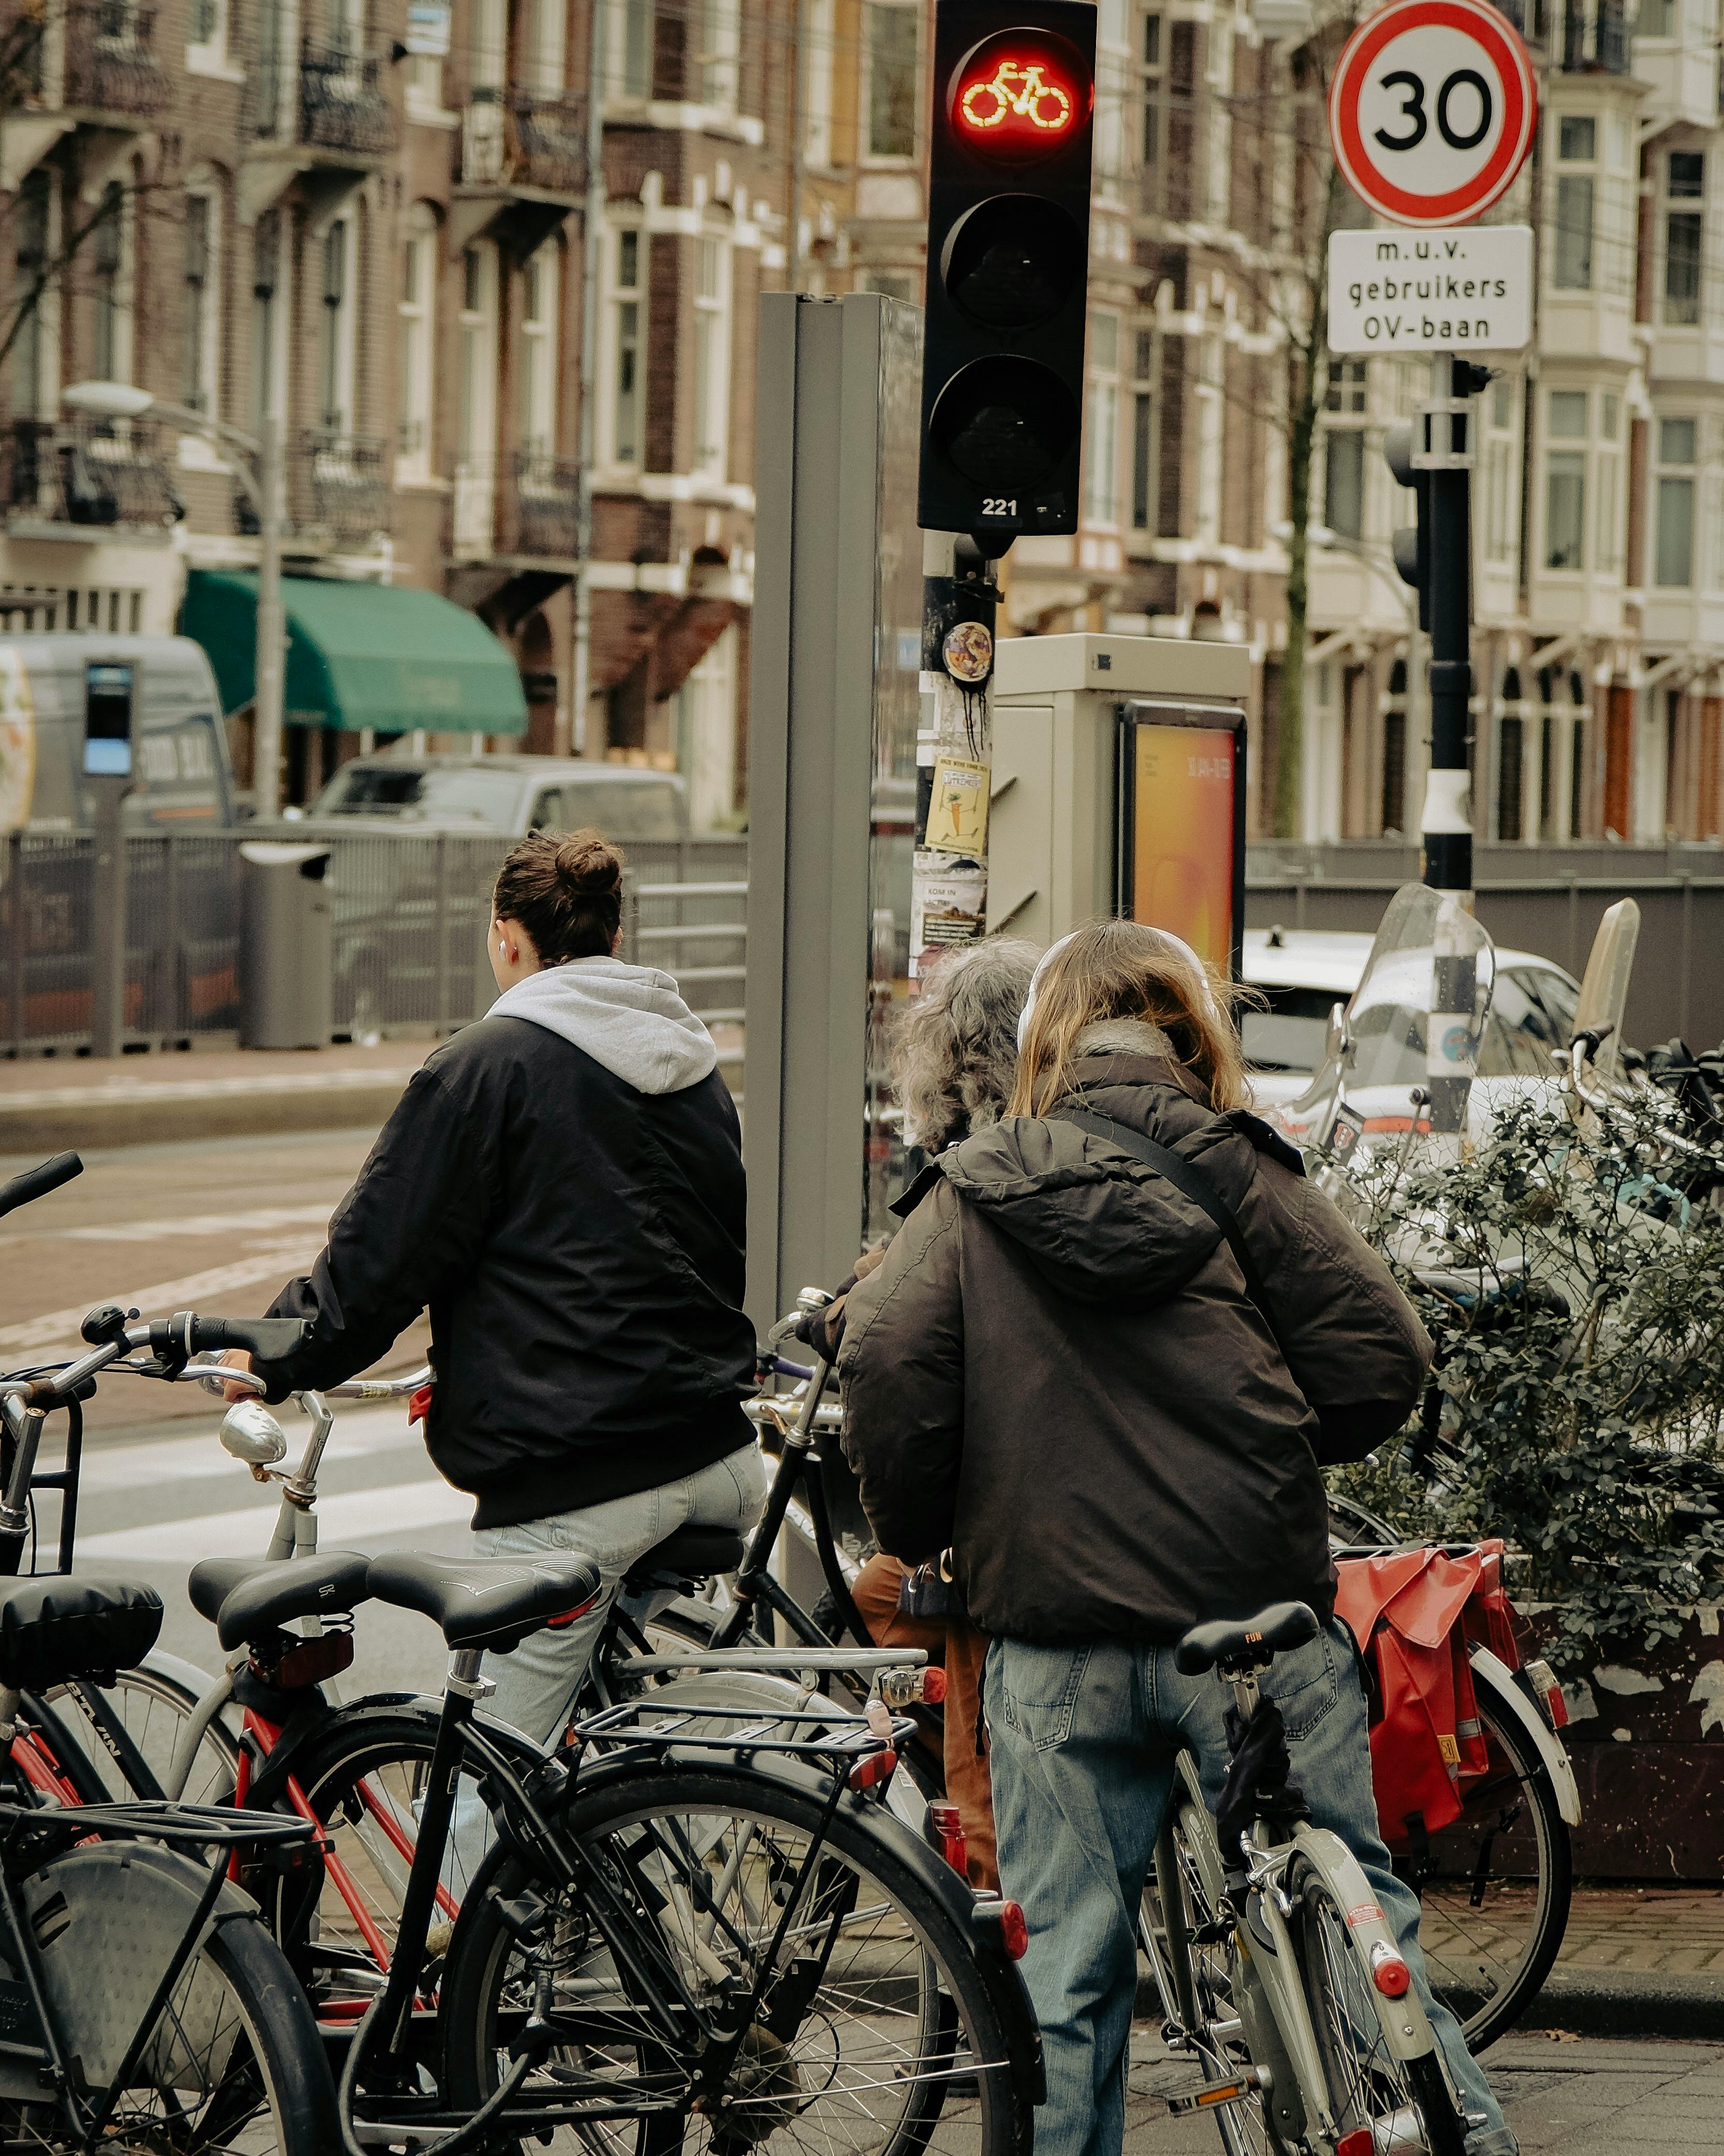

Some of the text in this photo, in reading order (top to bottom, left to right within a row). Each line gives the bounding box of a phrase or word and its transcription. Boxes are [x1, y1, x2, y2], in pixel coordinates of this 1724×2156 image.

[1374, 69, 1492, 151] 30
[1376, 240, 1467, 260] m.u.v.
[1348, 274, 1506, 308] gebruikers
[1363, 314, 1490, 339] OV-baan
[982, 498, 1017, 516] 221
[1245, 1631, 1262, 1644] FUN
